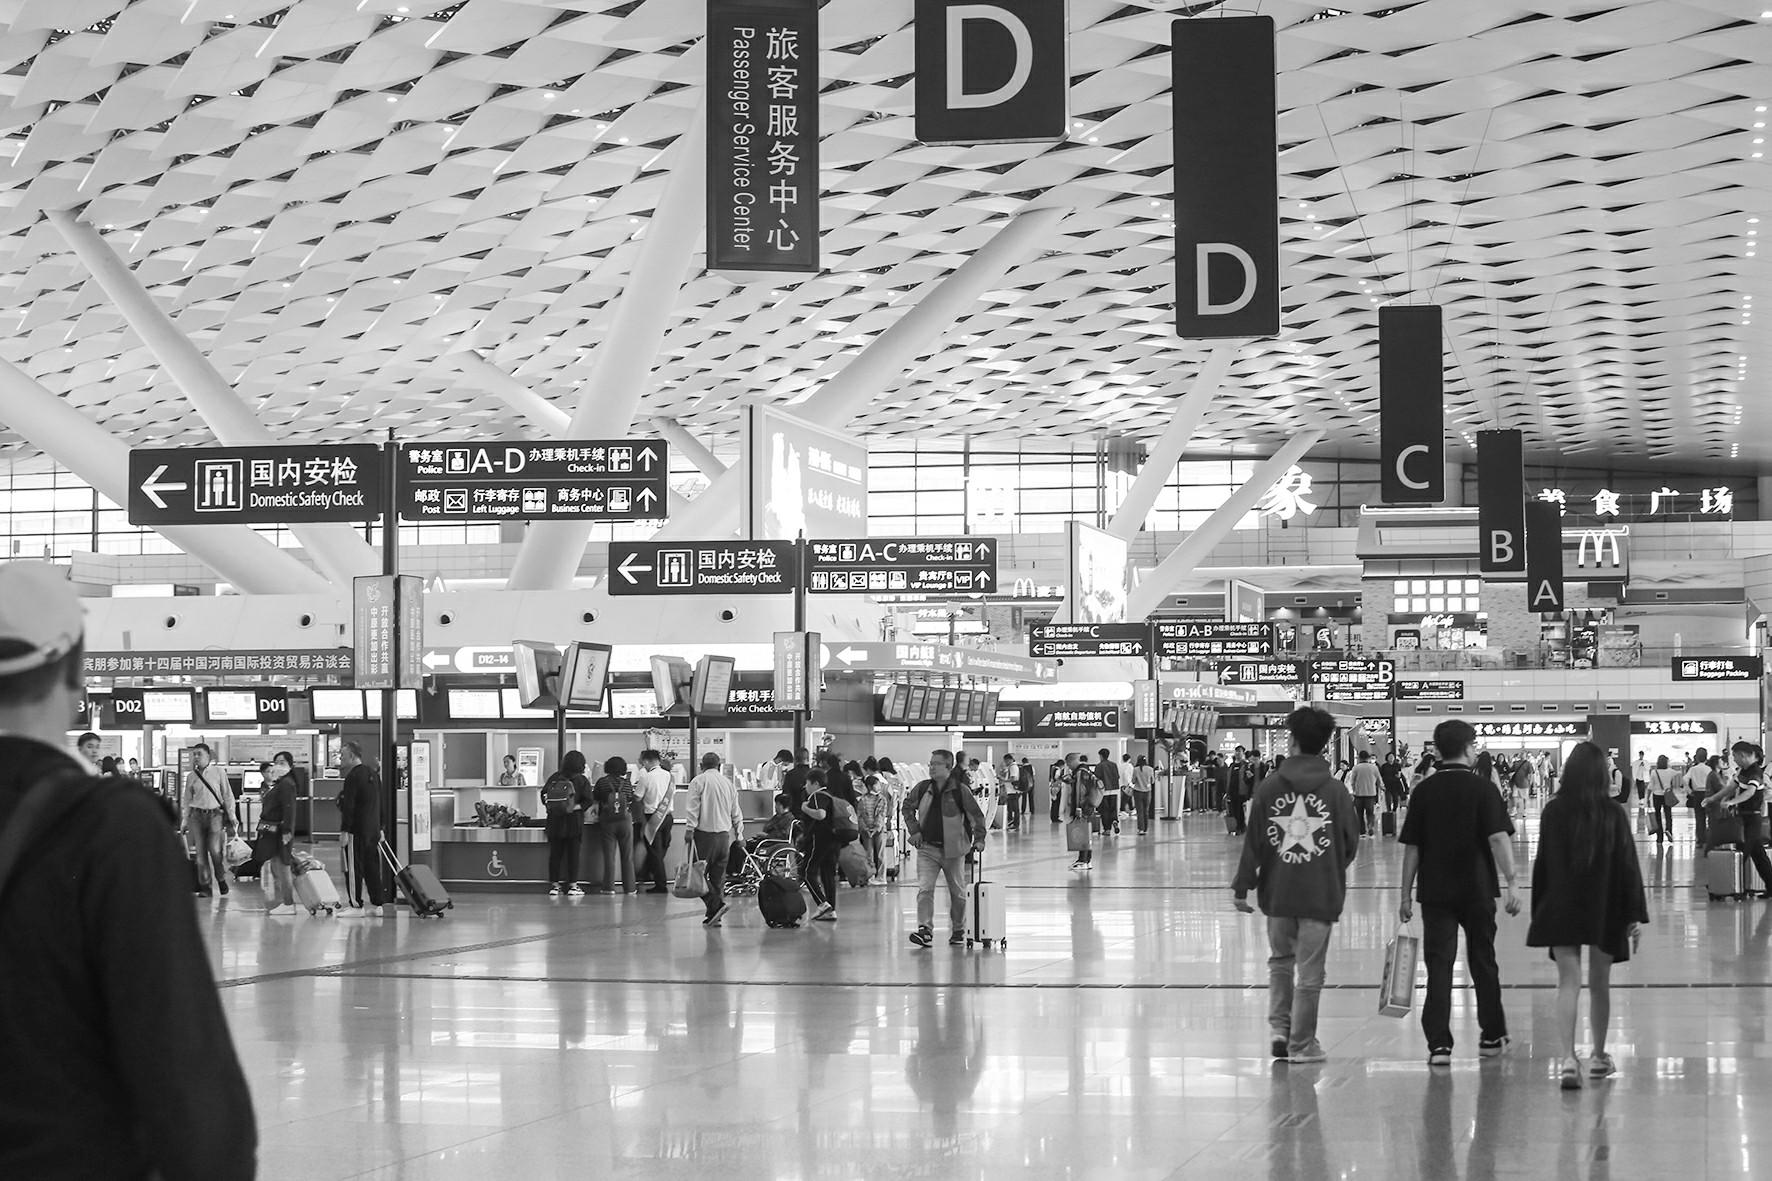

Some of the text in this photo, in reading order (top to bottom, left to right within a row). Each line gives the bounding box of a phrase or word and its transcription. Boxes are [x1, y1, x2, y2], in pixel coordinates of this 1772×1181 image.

[946, 5, 1033, 109] D
[728, 27, 755, 251] Passenger Service Center
[766, 27, 800, 252] 旅客服务中心
[1196, 242, 1257, 316] D
[409, 449, 443, 463] 警务室
[470, 448, 526, 473] A-D
[529, 447, 605, 462] 办理乘机手续
[250, 457, 358, 487] 国内安检
[417, 464, 443, 474] Police
[567, 463, 605, 473] Check-in
[1396, 445, 1430, 489] C
[250, 490, 364, 509] Domestic Safety Check
[414, 489, 441, 502] 邮政
[473, 489, 520, 502] 行李寄存
[558, 488, 604, 502] 商务中心
[422, 505, 440, 514] Post
[473, 504, 519, 515] Left Luggage
[552, 504, 604, 513] Business Center
[859, 543, 897, 561] A-C
[899, 543, 953, 553] 办理乘机手续
[1491, 530, 1514, 563] B
[698, 548, 776, 569] 国内安检
[698, 571, 781, 586] Domestic Safety Check
[956, 576, 970, 584] VIP
[1533, 580, 1559, 606] A
[1090, 626, 1099, 638] C
[1189, 625, 1213, 637] A-B
[479, 655, 509, 664] D12-14
[1700, 660, 1734, 670] 行李打包
[1259, 664, 1296, 674] 国内安检
[1379, 661, 1393, 682] B
[1726, 670, 1749, 678] Packing
[116, 701, 142, 712] D02
[260, 699, 285, 712] D01
[728, 704, 776, 713] rvice Check-
[1055, 711, 1102, 721] 南航自助值机
[1104, 711, 1116, 727] C
